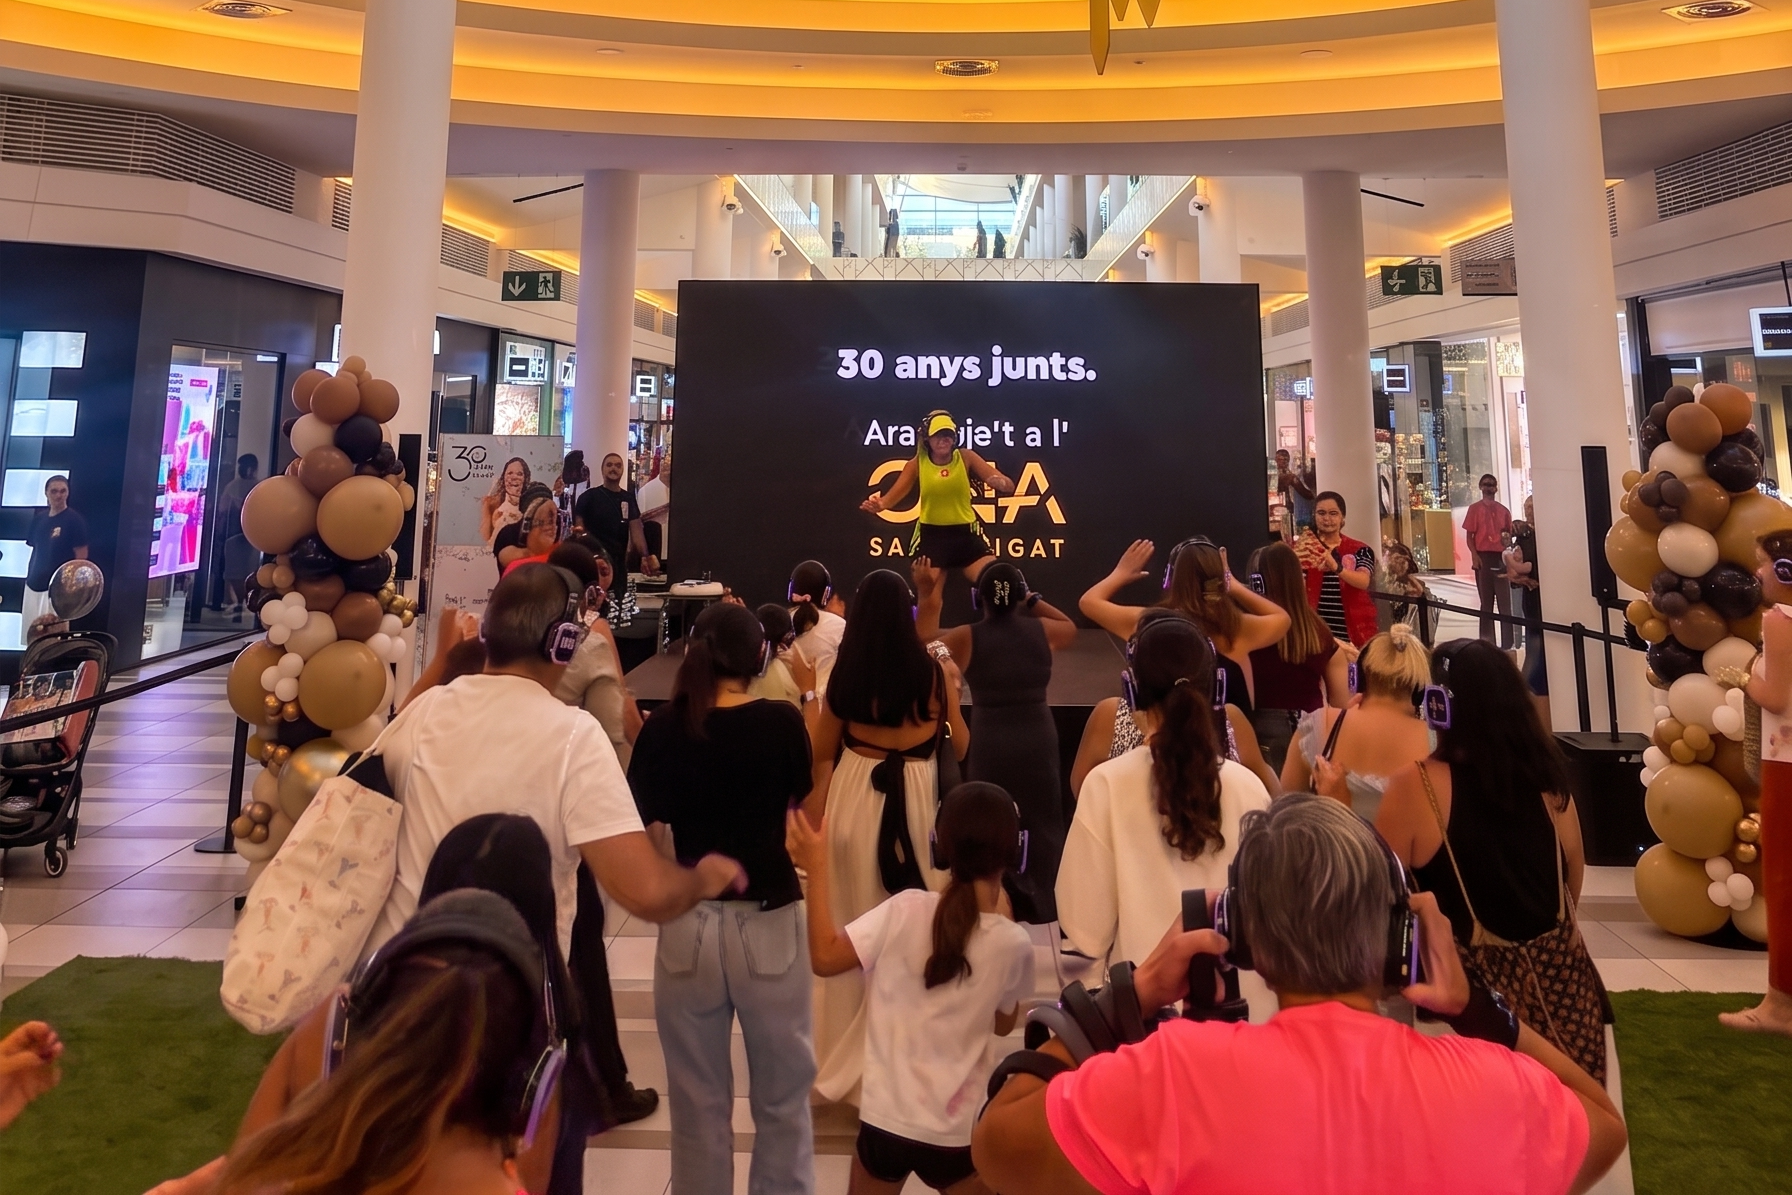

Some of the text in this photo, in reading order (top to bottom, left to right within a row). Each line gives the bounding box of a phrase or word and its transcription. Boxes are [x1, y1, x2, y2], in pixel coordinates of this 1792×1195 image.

[837, 345, 1097, 387] 30 anys junts.
[863, 419, 915, 447] Ara
[1025, 426, 1042, 447] a
[448, 445, 487, 482] 30
